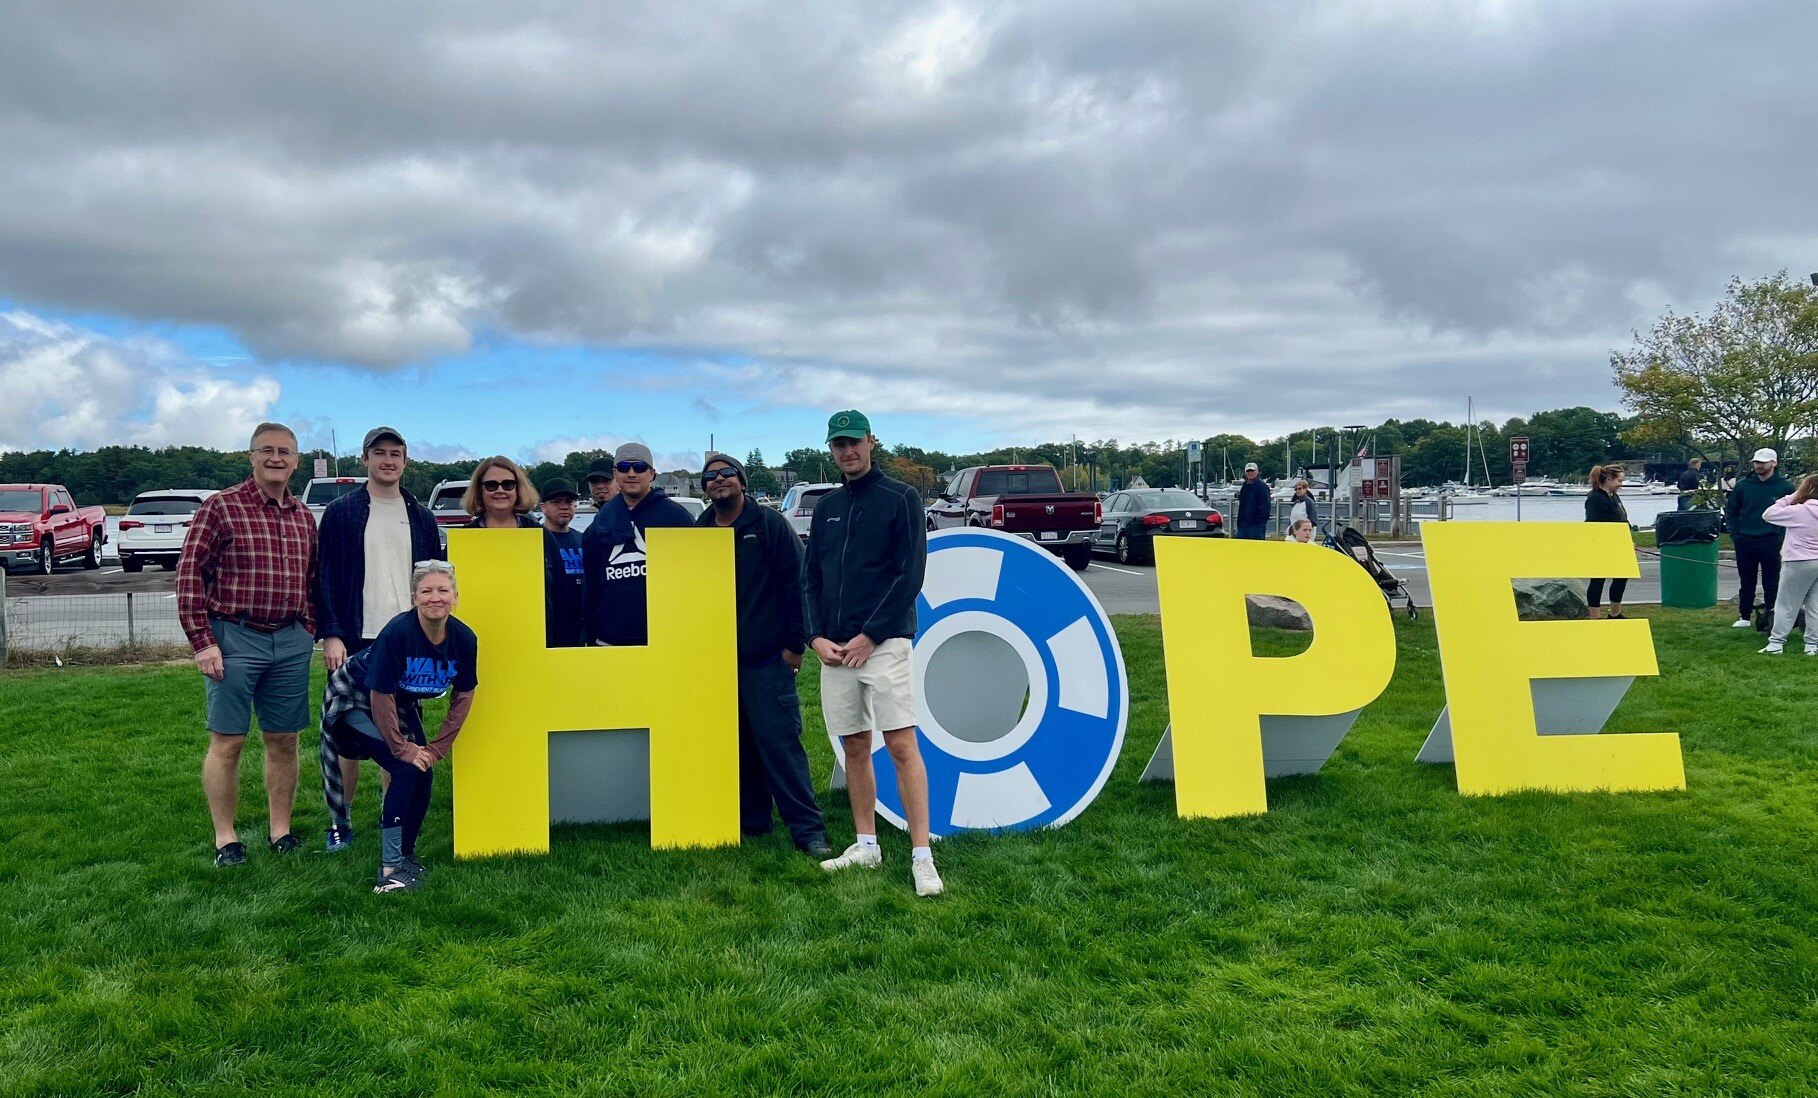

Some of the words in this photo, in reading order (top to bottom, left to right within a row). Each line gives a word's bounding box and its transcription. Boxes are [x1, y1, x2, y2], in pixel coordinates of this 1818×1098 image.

[605, 563, 647, 581] Reebo
[406, 656, 458, 677] WALK
[447, 520, 1686, 858] HOPE
